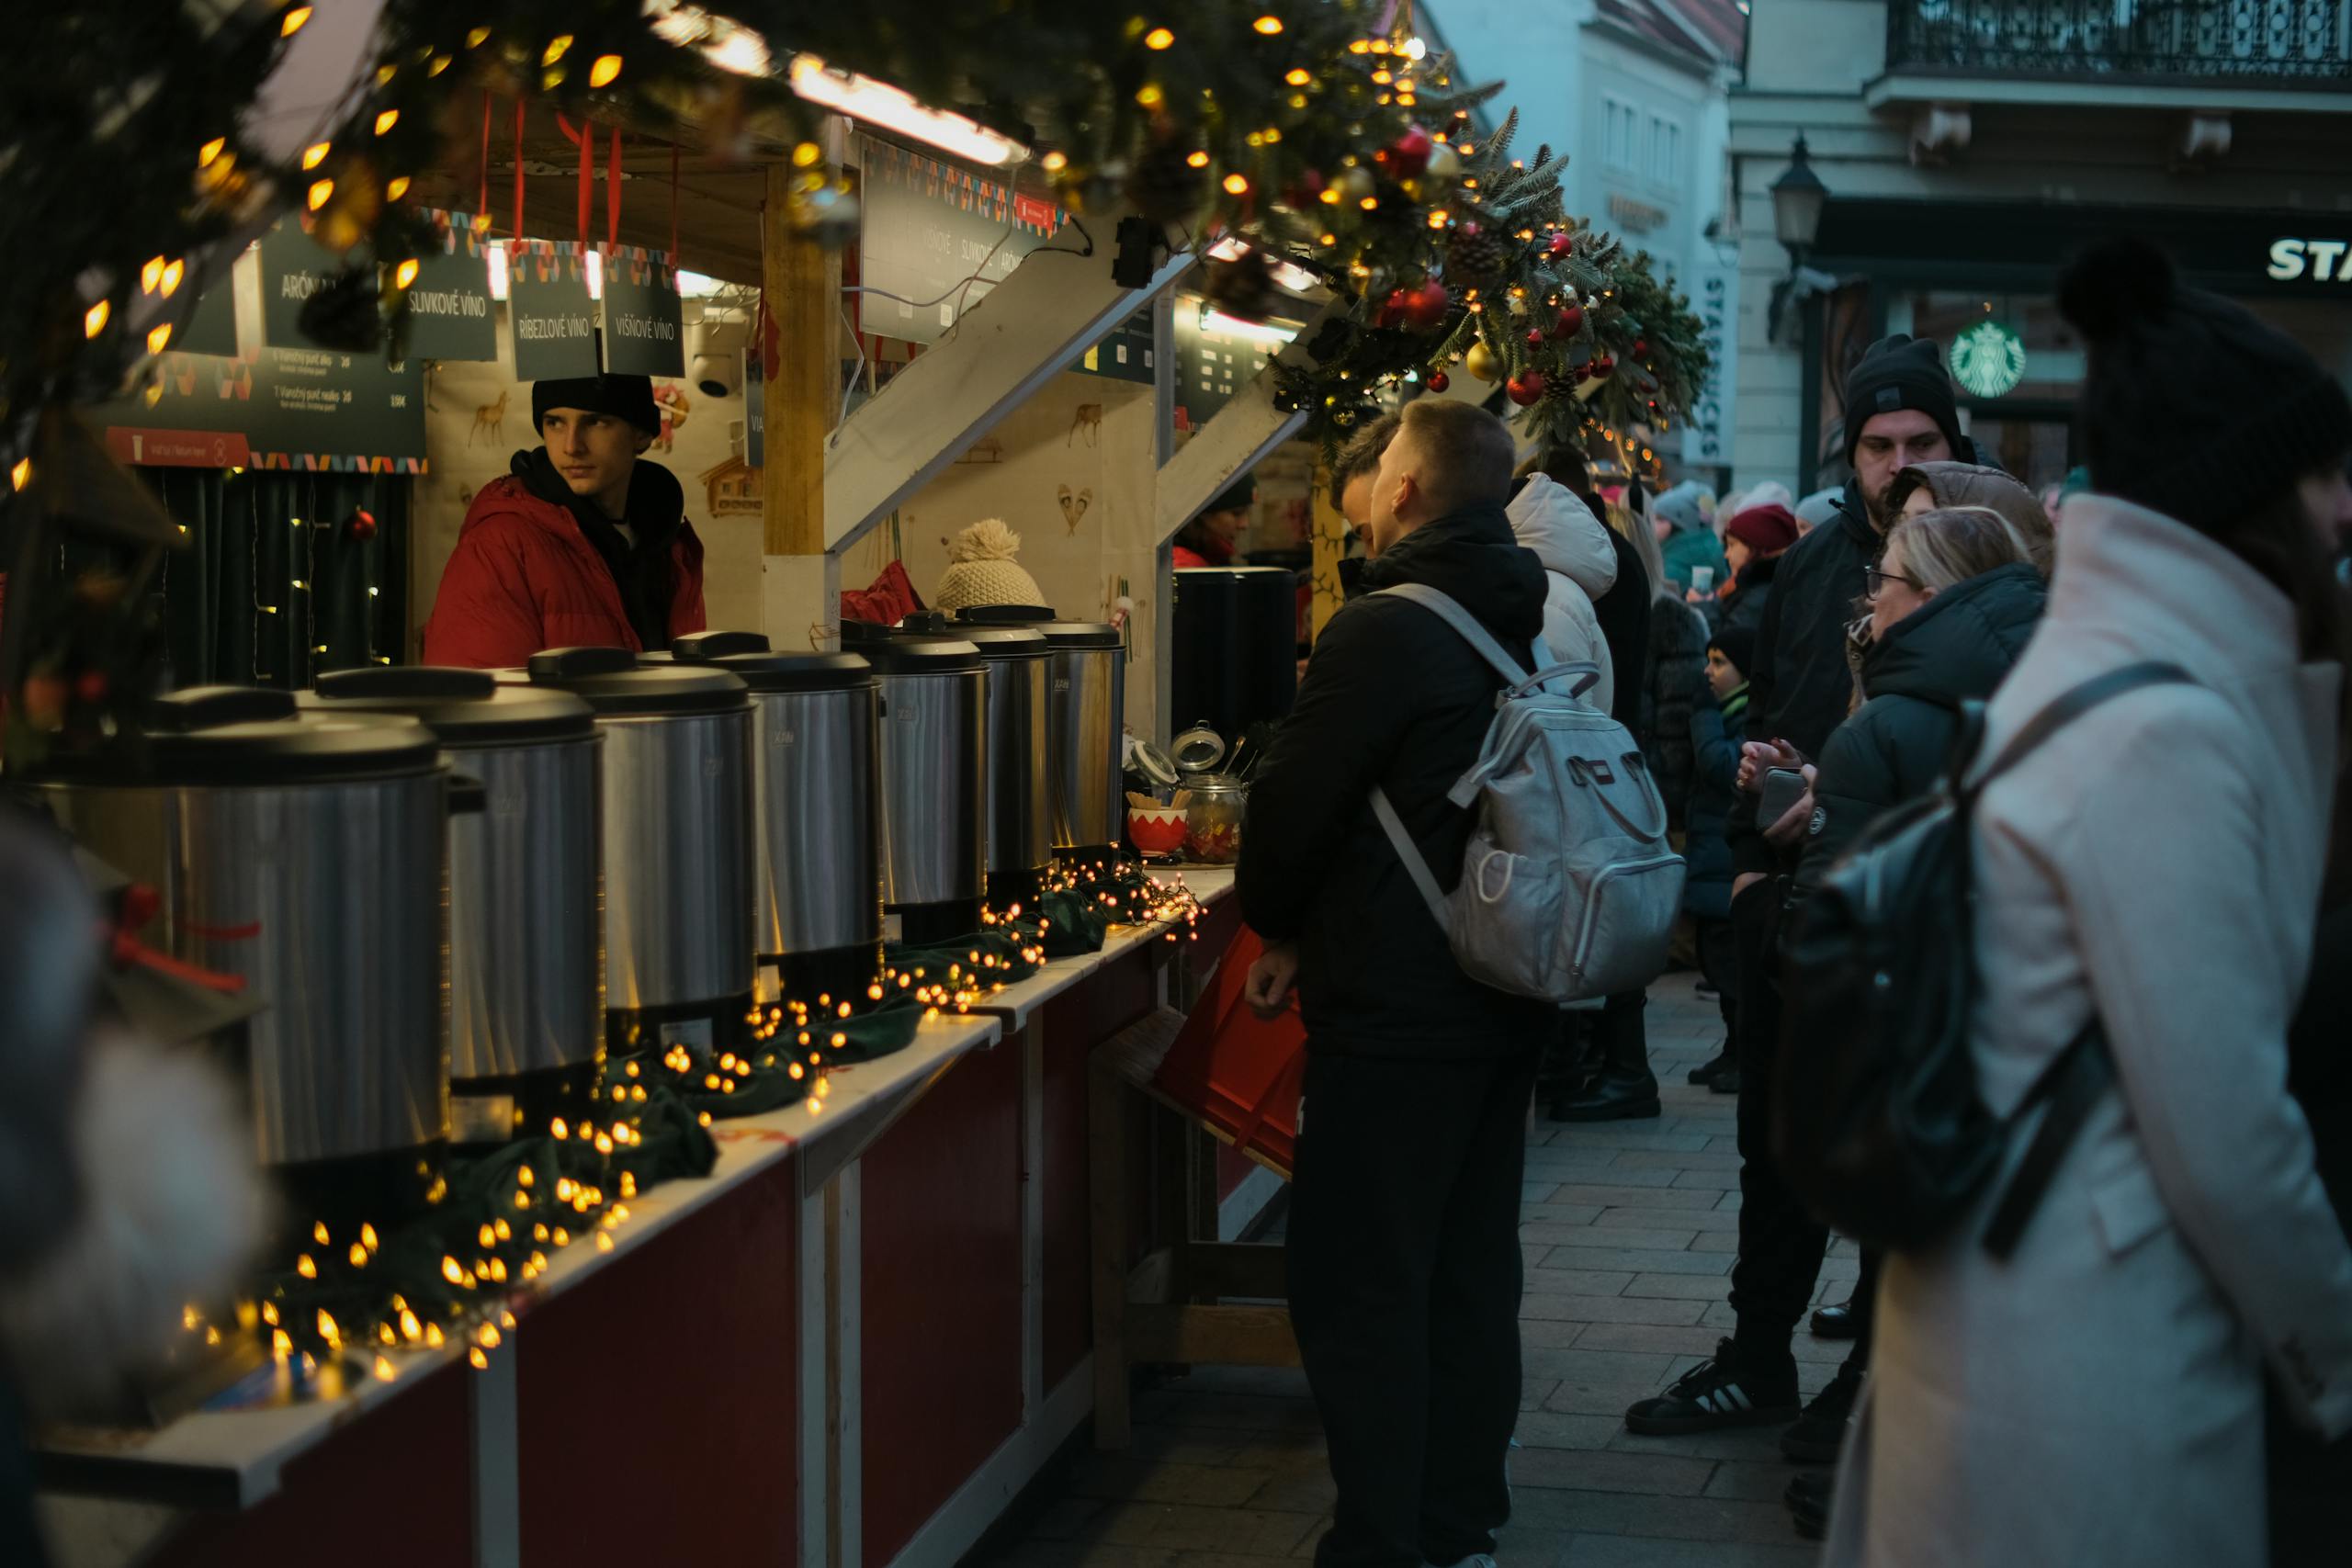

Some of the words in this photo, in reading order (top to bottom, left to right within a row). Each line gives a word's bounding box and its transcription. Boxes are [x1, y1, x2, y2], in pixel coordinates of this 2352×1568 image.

[409, 288, 459, 316] SLIVKOVÉ
[460, 290, 486, 318] VÍNO
[519, 312, 566, 339] RÍBEZLOVÉ
[568, 313, 589, 338] VÍNO
[616, 312, 652, 339] VIŠŇOVÉ
[653, 317, 674, 341] VÍNO
